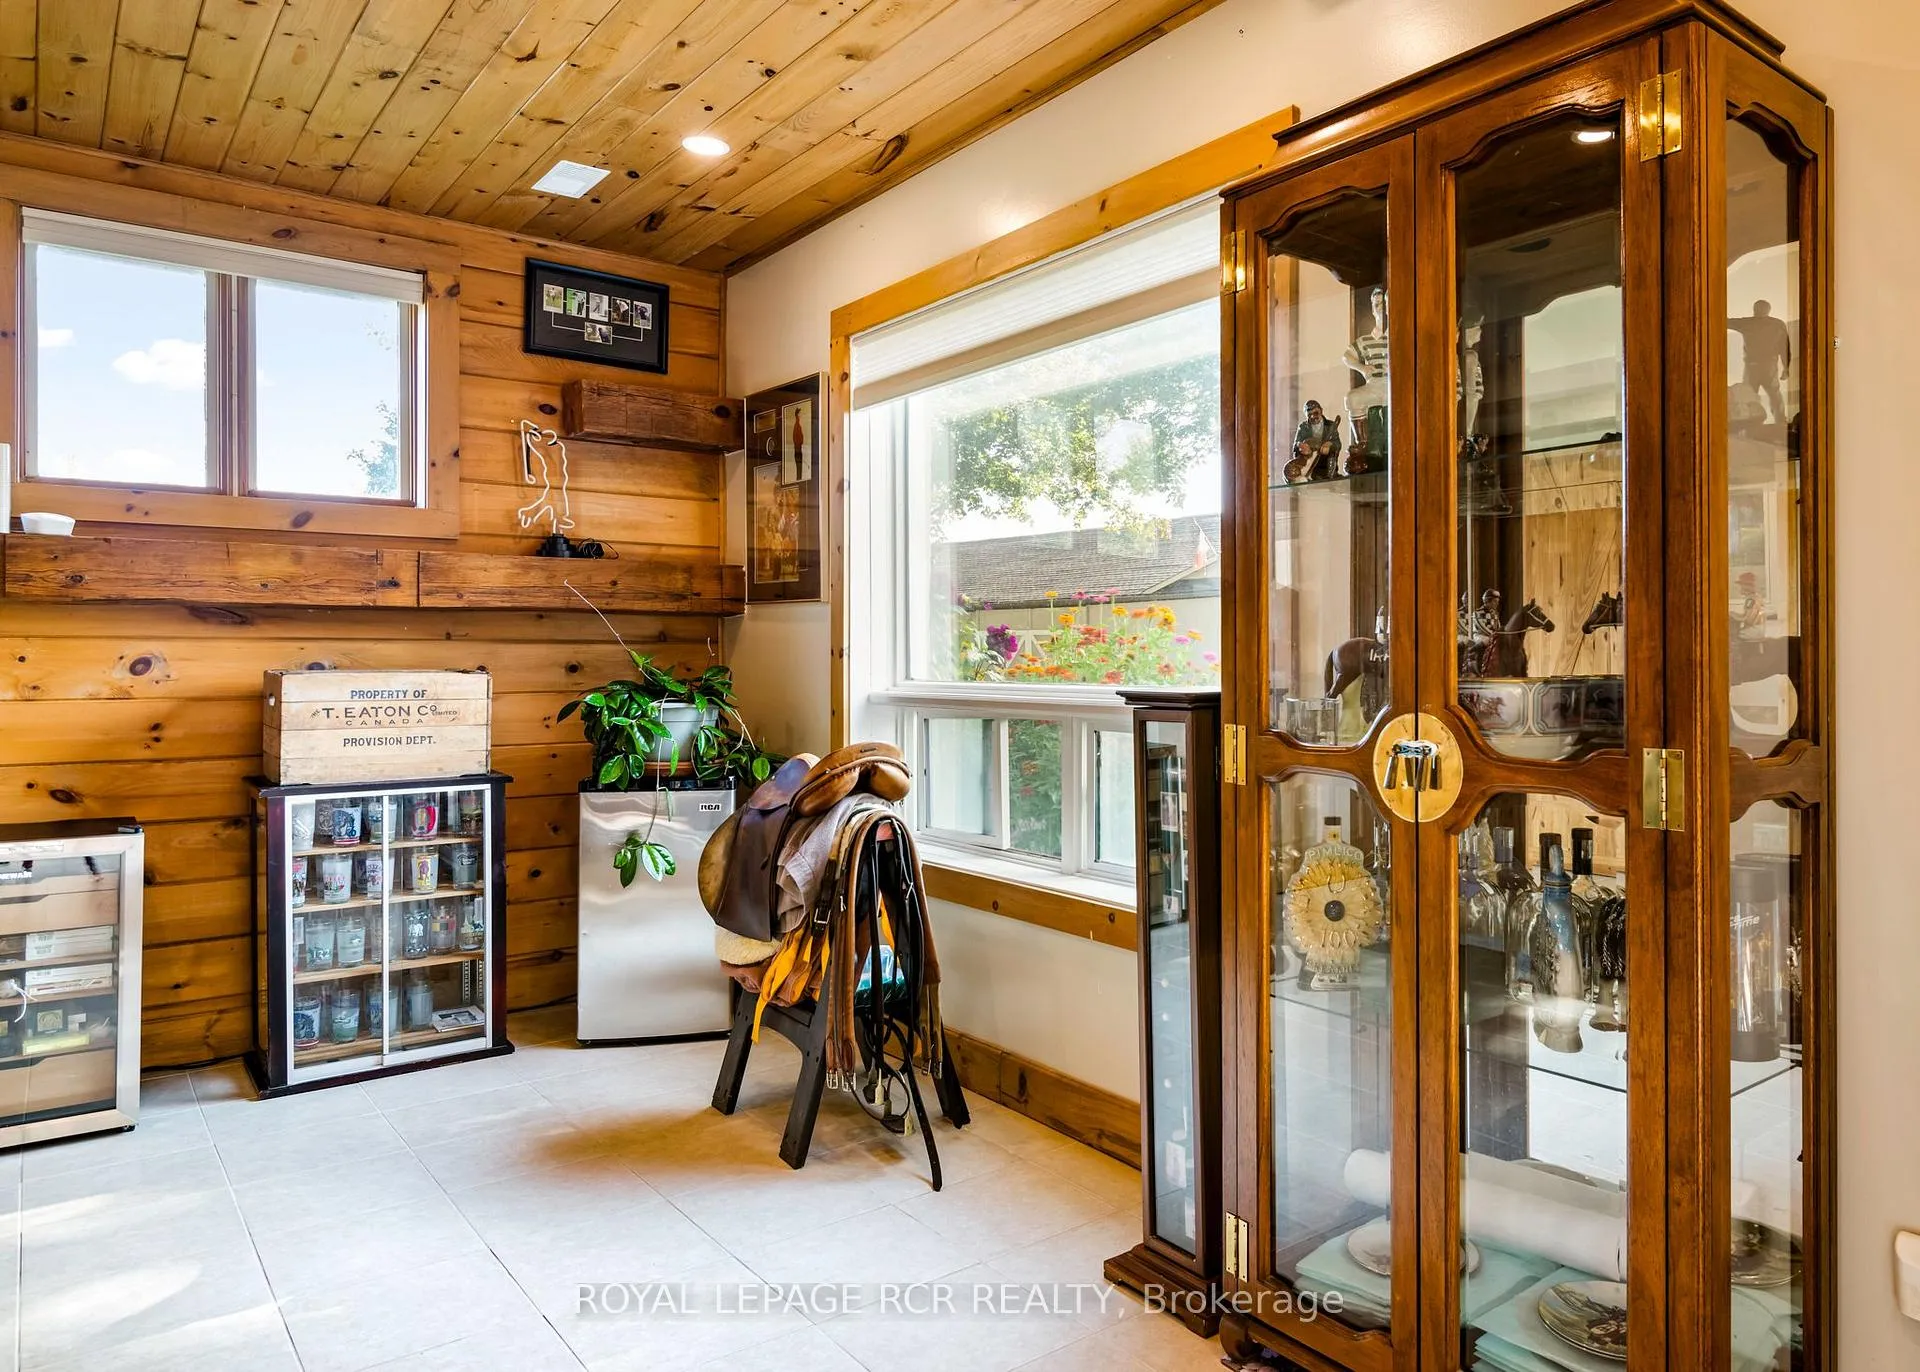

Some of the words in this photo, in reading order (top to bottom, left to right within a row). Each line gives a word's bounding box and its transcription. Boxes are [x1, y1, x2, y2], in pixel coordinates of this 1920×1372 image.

[350, 689, 409, 700] PROPERTY
[413, 689, 427, 698] OF
[321, 707, 340, 719] T.
[344, 705, 411, 719] EATON
[345, 718, 424, 727] CANADA
[343, 736, 402, 748] PROVISION
[405, 735, 437, 746] DEPT.
[1309, 846, 1361, 859] PIMLICO
